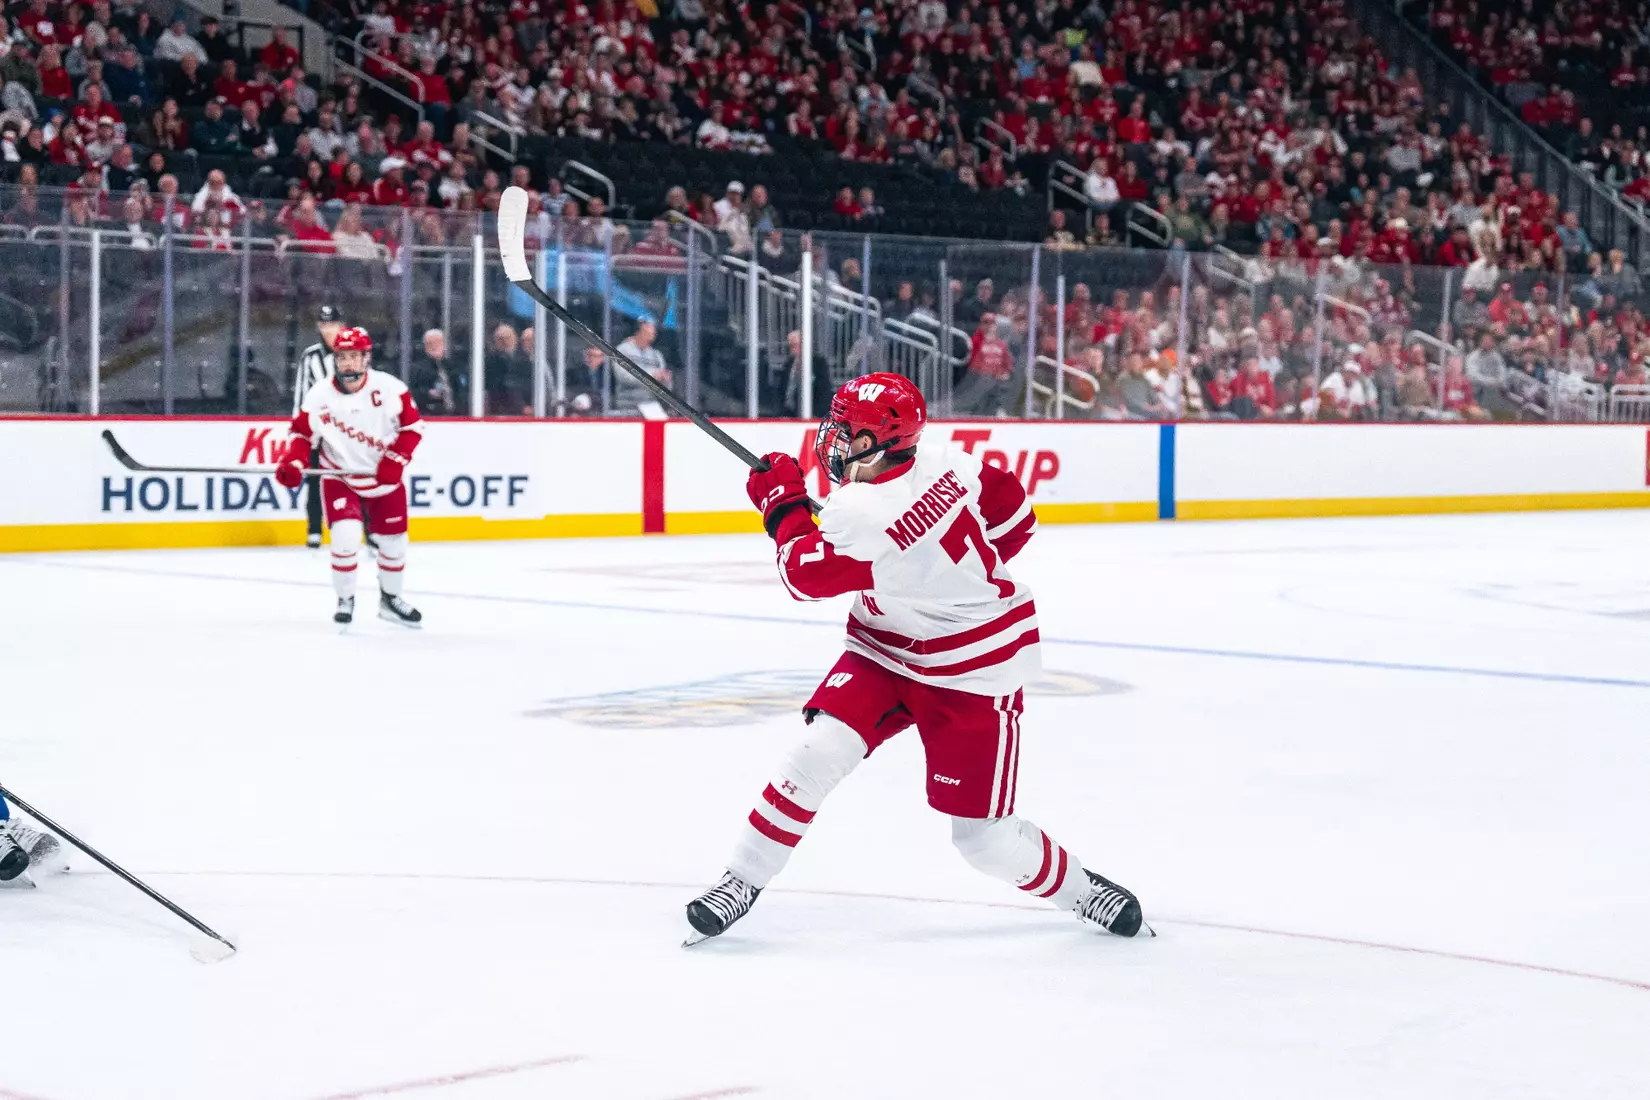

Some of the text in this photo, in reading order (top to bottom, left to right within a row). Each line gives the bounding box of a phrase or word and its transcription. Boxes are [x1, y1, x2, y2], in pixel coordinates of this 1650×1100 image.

[370, 391, 383, 408] C
[858, 383, 886, 402] W
[102, 477, 309, 512] HOLIDAY
[938, 504, 1016, 600] 7
[825, 672, 854, 689] W
[933, 773, 961, 786] CCM
